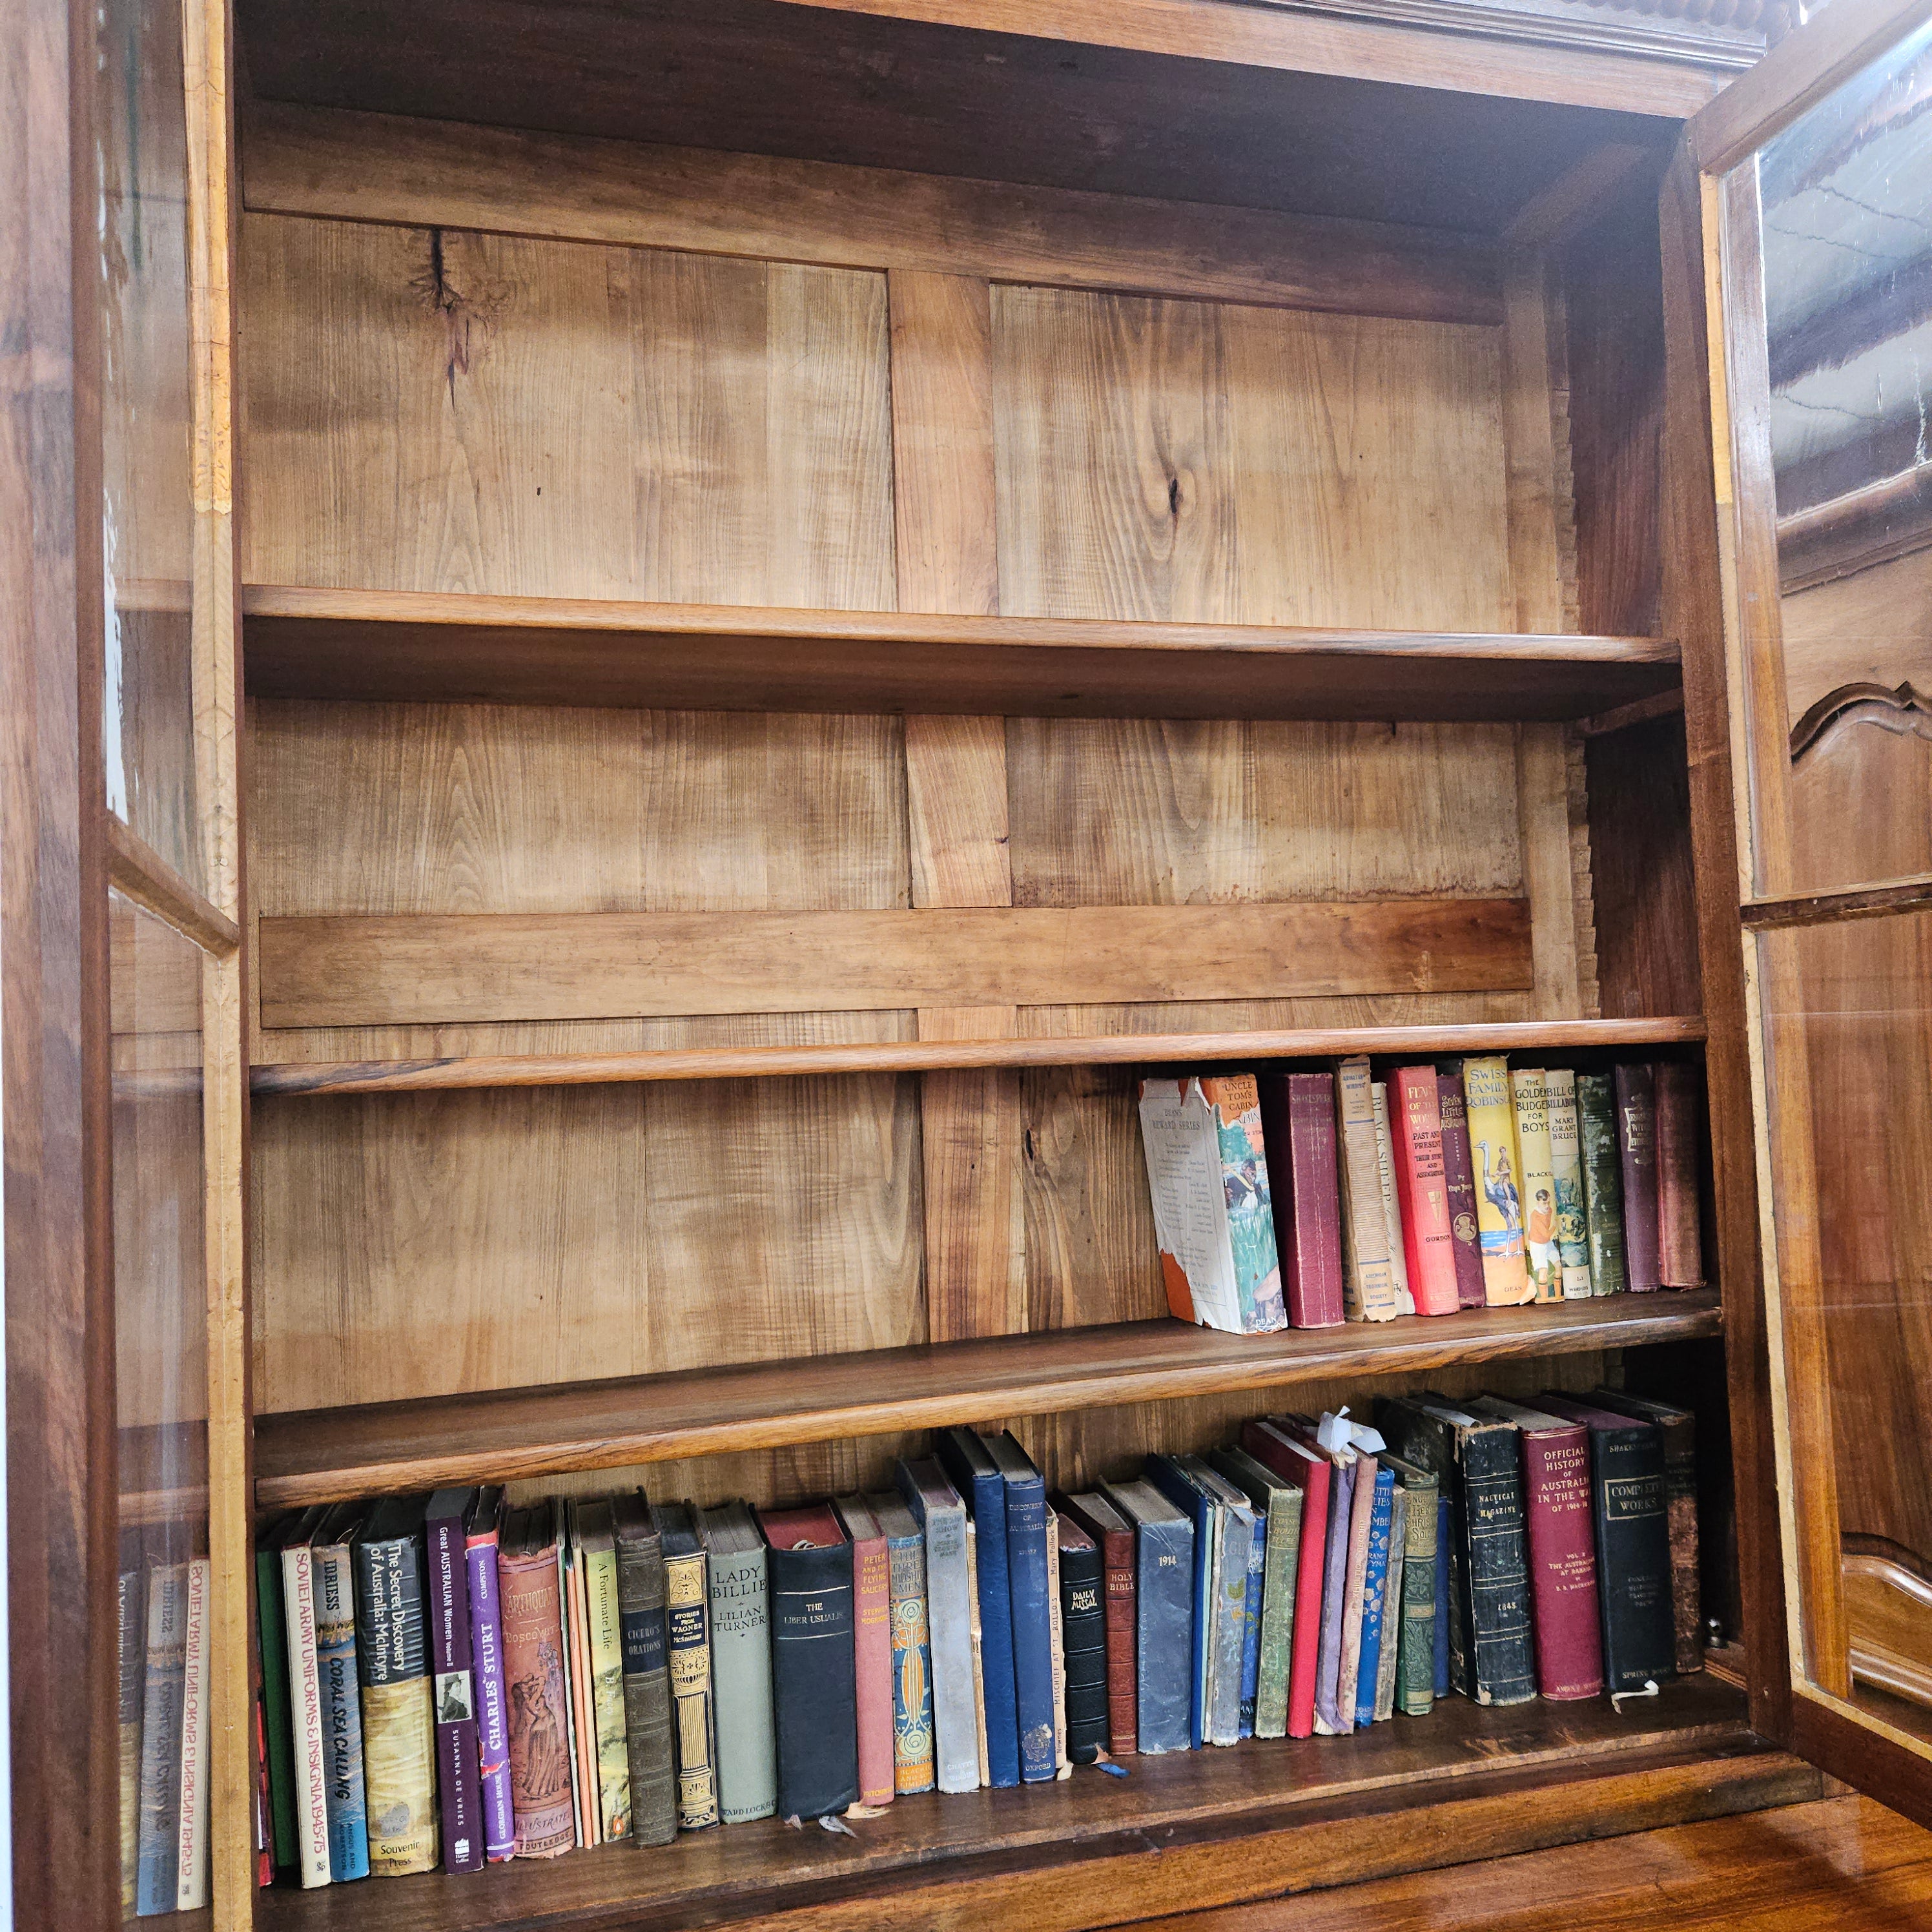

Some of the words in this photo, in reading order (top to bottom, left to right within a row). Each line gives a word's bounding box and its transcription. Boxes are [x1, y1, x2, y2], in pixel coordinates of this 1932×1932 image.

[1470, 1068, 1506, 1081] SWISS
[1224, 1081, 1253, 1091] UNCLE
[1468, 1082, 1508, 1094] FAMILY
[1547, 1086, 1567, 1097] BILL
[1227, 1089, 1253, 1102] TOM'S
[1228, 1101, 1253, 1111] CABIN
[1409, 1102, 1421, 1111] OF
[1516, 1100, 1547, 1111] BUDGE
[1527, 1112, 1543, 1120] FOR
[1554, 1116, 1575, 1125] MARY
[1521, 1121, 1550, 1133] BOYS
[1552, 1124, 1576, 1133] GRANT
[1412, 1131, 1430, 1141] PAST
[1552, 1132, 1577, 1140] BRUCE
[1414, 1140, 1441, 1150] PRESENT
[1424, 1234, 1452, 1243] GORDON
[1255, 1316, 1277, 1325] DEAN
[1543, 1446, 1585, 1461] OFFICIAL
[1546, 1457, 1585, 1472] HISTORY
[1373, 1497, 1390, 1506] LIES
[1479, 1492, 1515, 1503] NAUTICAL
[1537, 1494, 1550, 1504] IN
[1554, 1492, 1576, 1502] THE
[1579, 1487, 1591, 1498] WA
[1551, 1504, 1563, 1514] OF
[1619, 1496, 1658, 1511] WORKS
[1479, 1505, 1516, 1519] MAGAZINE
[439, 1526, 449, 1551] Great
[370, 1548, 385, 1561] of
[387, 1543, 402, 1568] The
[864, 1552, 885, 1564] PETER
[1158, 1555, 1178, 1567] 1914
[598, 1563, 608, 1572] A
[296, 1553, 311, 1600] SOVIET
[441, 1551, 454, 1606] AUSTRALIAN
[478, 1559, 488, 1599] CUMPSTON
[715, 1565, 761, 1584] LADY
[863, 1572, 887, 1584] FLYING
[1111, 1572, 1133, 1582] HOLY
[324, 1558, 340, 1611] IDRIESS
[389, 1568, 403, 1609] Secret
[712, 1579, 767, 1599] BILLIE
[1109, 1581, 1135, 1591] BIBLE
[371, 1563, 387, 1622] Australia:
[1073, 1589, 1094, 1601] DAILY
[599, 1574, 611, 1626] Fortunate
[1071, 1597, 1098, 1610] MISSAL
[719, 1605, 762, 1621] LILIAN
[805, 1602, 823, 1612] THE
[674, 1610, 700, 1620] STORIES
[784, 1616, 808, 1625] LIBER
[299, 1605, 314, 1645] ARMY
[444, 1607, 453, 1641] Women
[714, 1616, 767, 1632] TURNER
[628, 1623, 661, 1640] CICERO'S
[391, 1610, 406, 1671] Discovery
[601, 1628, 615, 1650] Life
[375, 1623, 388, 1681] McIntyre
[446, 1641, 454, 1662] Volume
[481, 1623, 496, 1674] STURT
[628, 1640, 661, 1656] ORATIONS
[1053, 1651, 1059, 1662] AT
[329, 1657, 345, 1701] CORAL
[302, 1648, 318, 1726] UNIFORMS
[331, 1705, 347, 1734] SEA
[486, 1680, 502, 1751] CHARLES
[307, 1729, 320, 1738] &
[452, 1729, 461, 1776] SUSANNA
[308, 1740, 324, 1804] INSIGNIA
[333, 1737, 351, 1800] CALLING
[1025, 1762, 1051, 1773] OXFORD
[455, 1780, 463, 1793] DE
[493, 1773, 506, 1799] HOUSE
[745, 1804, 765, 1814] LOCK
[495, 1799, 506, 1840] GEORGIAN
[380, 1840, 420, 1855] Souvenir
[389, 1857, 412, 1867] Press
